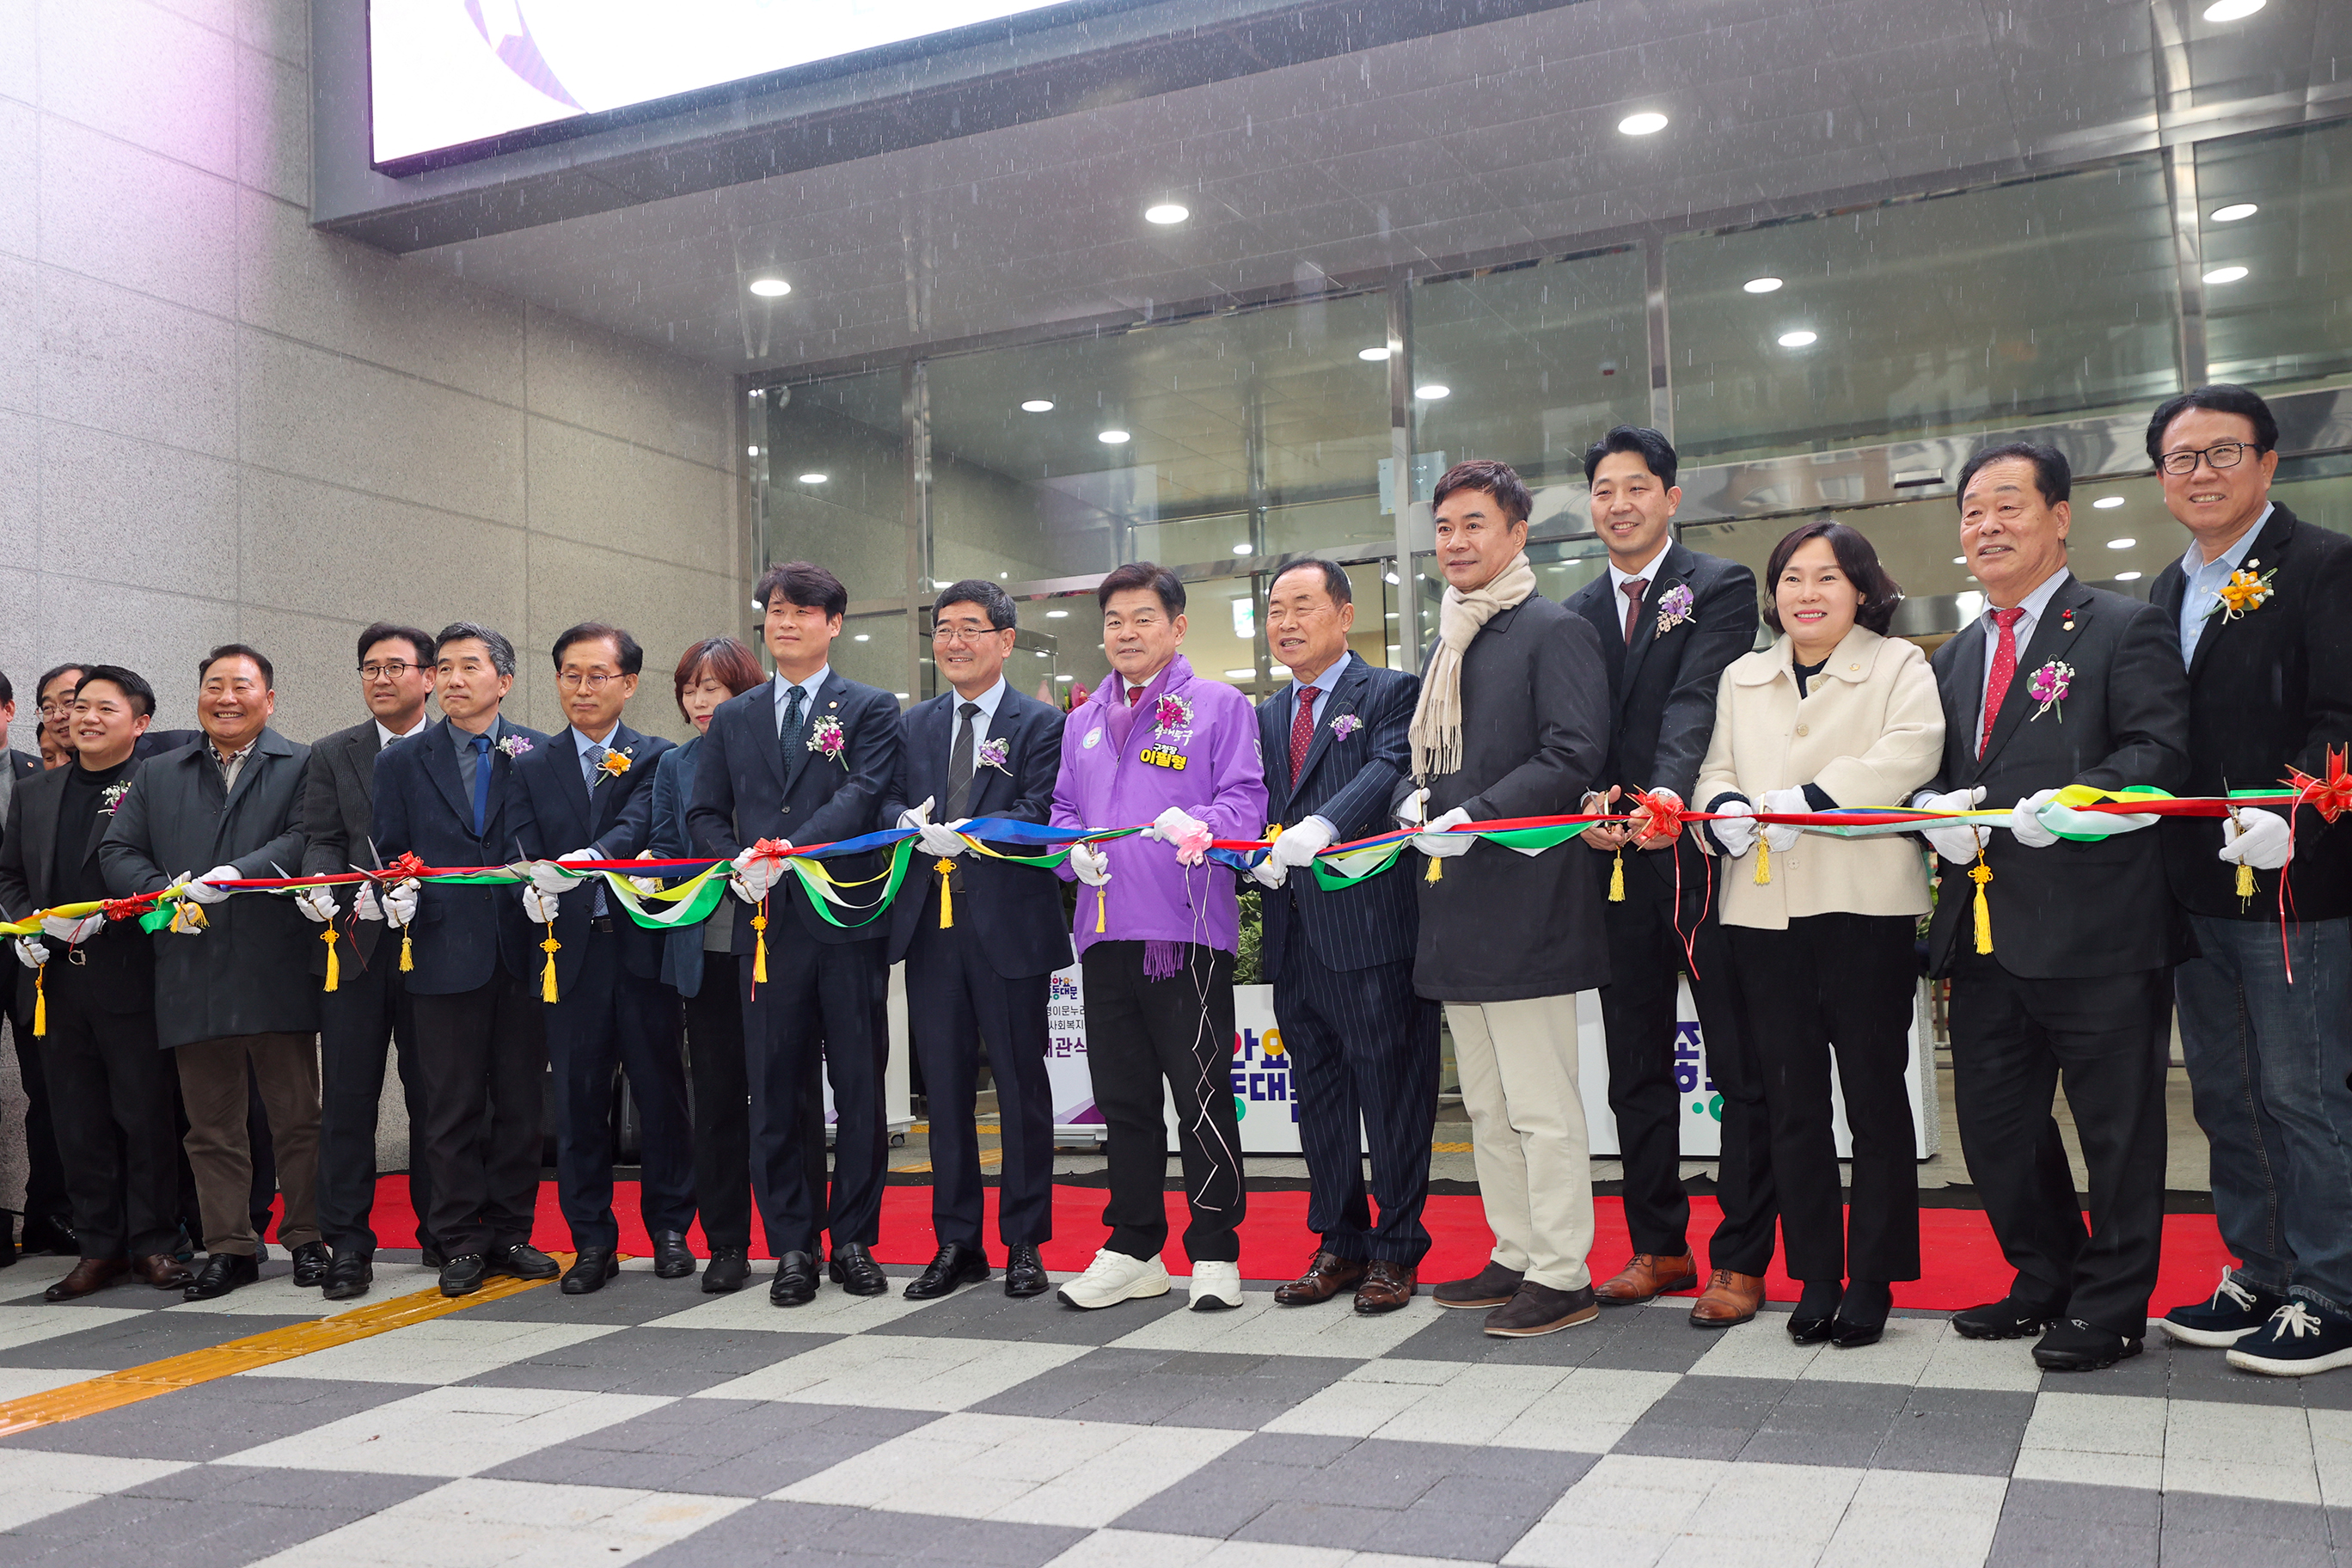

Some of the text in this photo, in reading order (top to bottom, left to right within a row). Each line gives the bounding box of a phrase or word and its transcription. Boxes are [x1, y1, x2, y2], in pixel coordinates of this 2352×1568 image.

[1153, 743, 1178, 755] 구청장
[1140, 749, 1187, 770] 이필형
[1050, 977, 1070, 987] 아요
